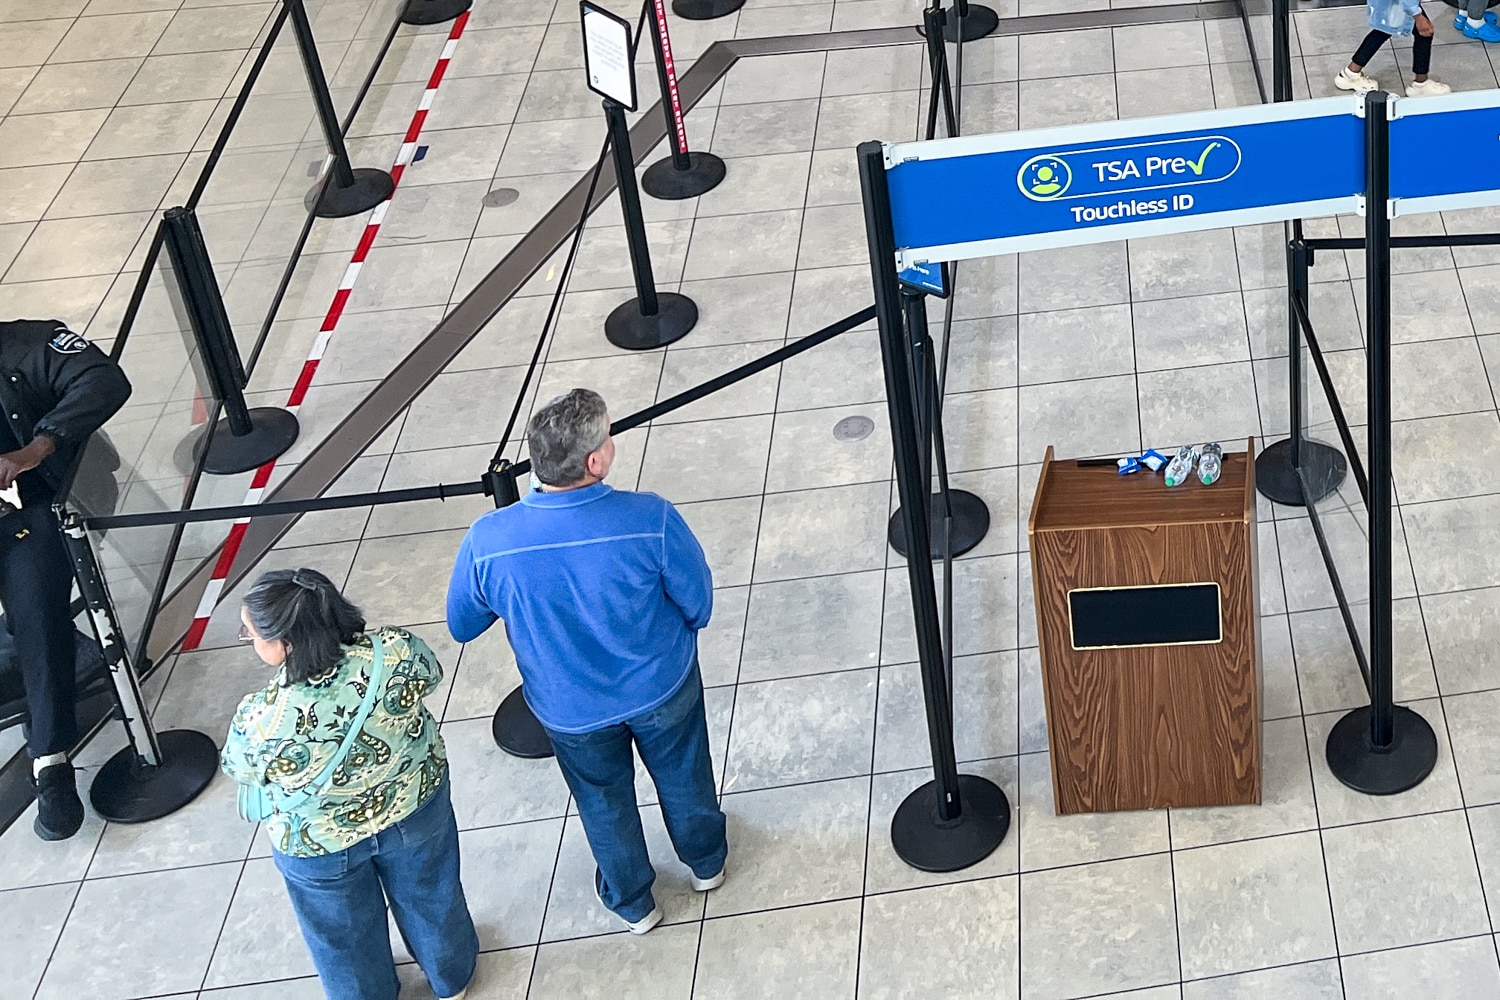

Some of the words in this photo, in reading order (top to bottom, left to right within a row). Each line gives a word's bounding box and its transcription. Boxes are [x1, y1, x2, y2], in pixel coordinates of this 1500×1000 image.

[1092, 160, 1141, 182] TSA
[1146, 156, 1186, 177] Pre
[1070, 198, 1168, 223] Touchless
[1172, 194, 1194, 211] ID
